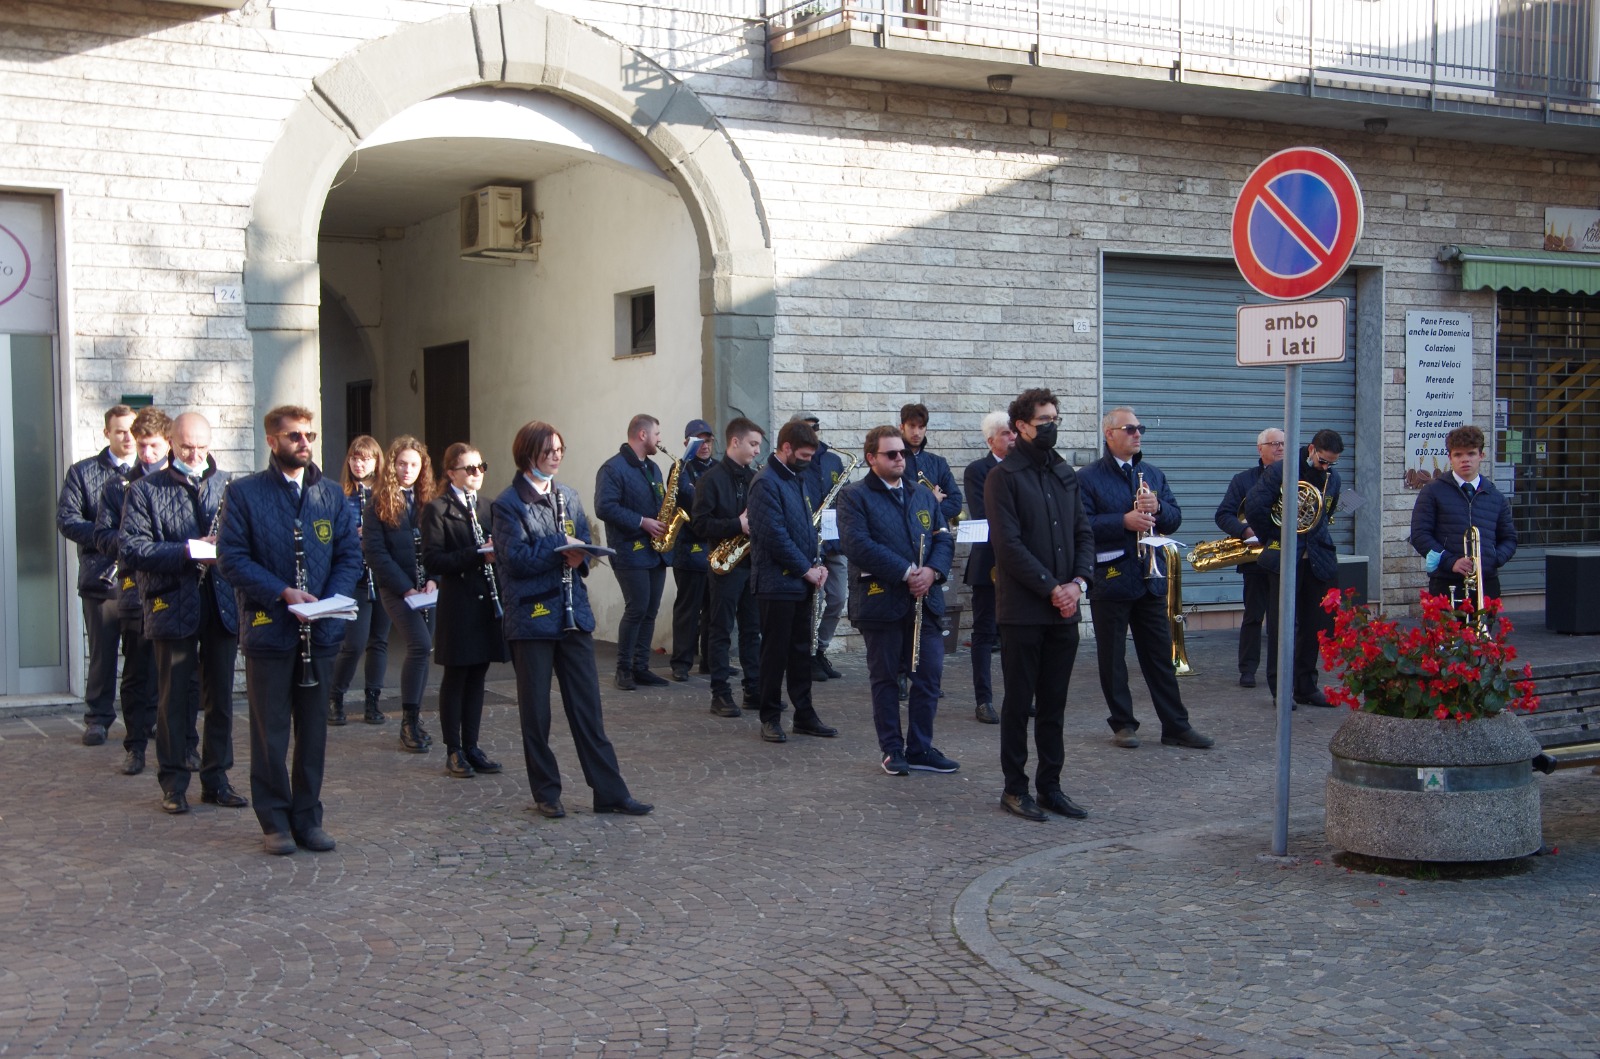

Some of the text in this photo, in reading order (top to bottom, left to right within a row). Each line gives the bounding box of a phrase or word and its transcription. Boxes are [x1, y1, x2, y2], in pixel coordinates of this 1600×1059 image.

[220, 288, 236, 301] 24
[1265, 311, 1318, 331] ambo
[1420, 317, 1460, 326] Pane Fresco
[1076, 321, 1087, 331] 25
[1408, 328, 1470, 337] anche la Domenica
[1266, 336, 1316, 356] i lati
[1424, 344, 1456, 352] Colazioni
[1418, 359, 1461, 368] Pranzi Veloci
[1425, 375, 1455, 383] Merende
[1425, 391, 1455, 400] Aperitivi
[1416, 409, 1463, 418] Organizziamo
[1408, 432, 1421, 440] per
[1421, 431, 1437, 440] ogni
[1415, 448, 1449, 456] 030.72.82
